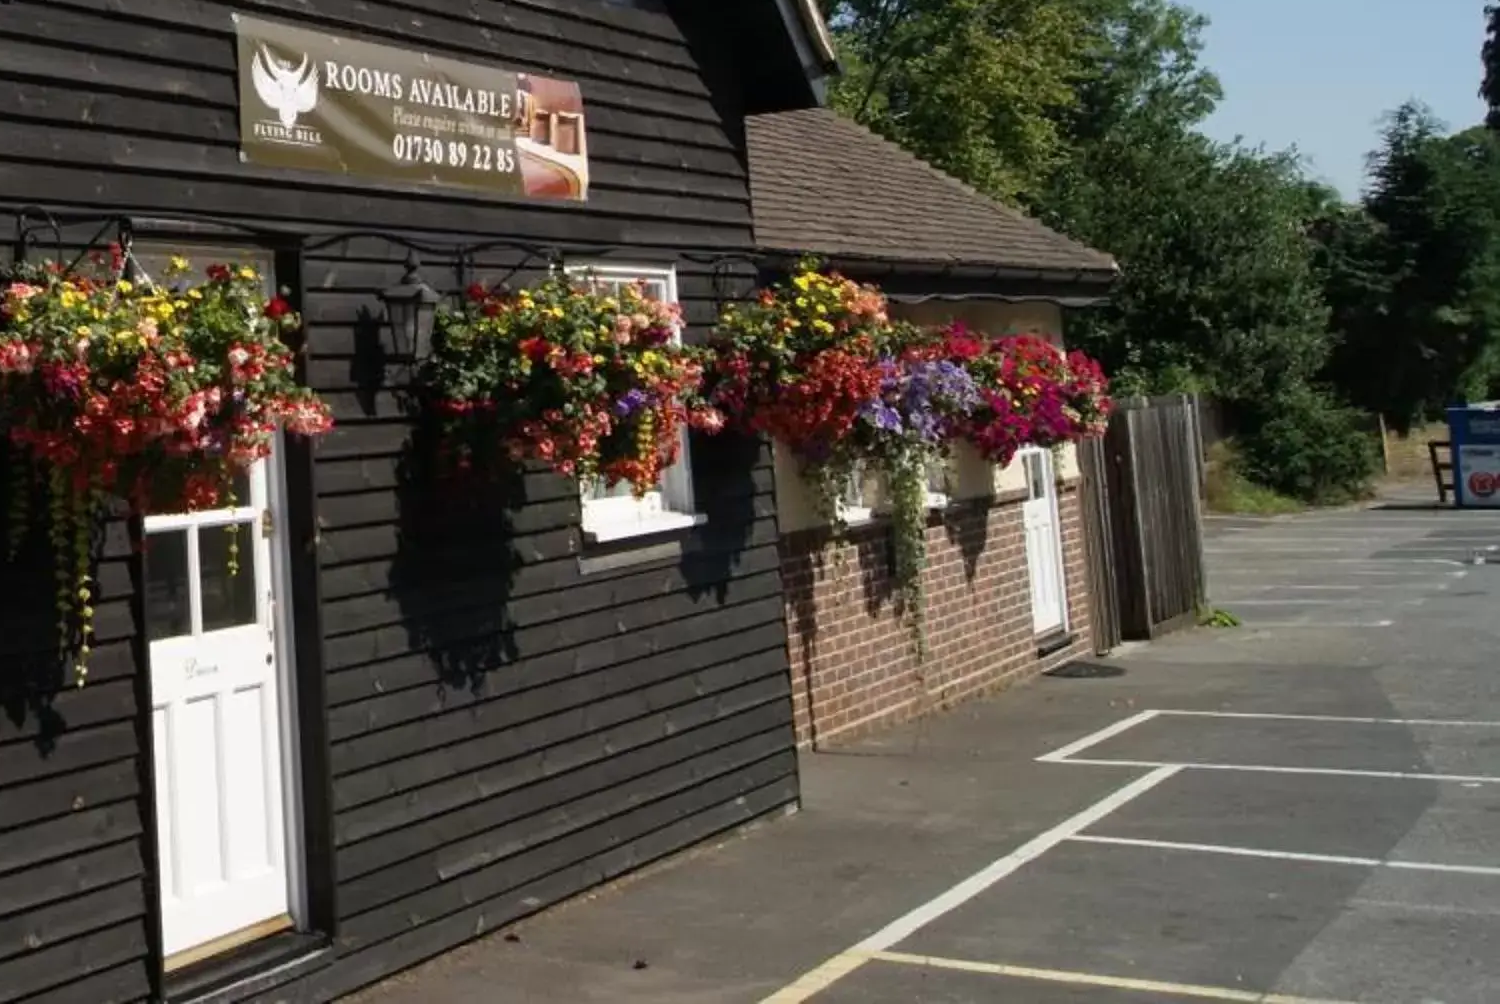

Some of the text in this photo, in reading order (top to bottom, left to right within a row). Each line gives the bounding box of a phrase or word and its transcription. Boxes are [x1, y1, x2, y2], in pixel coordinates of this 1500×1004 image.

[325, 60, 512, 119] ROOMS AVAILABLE
[393, 133, 515, 173] 01730 89 22 85
